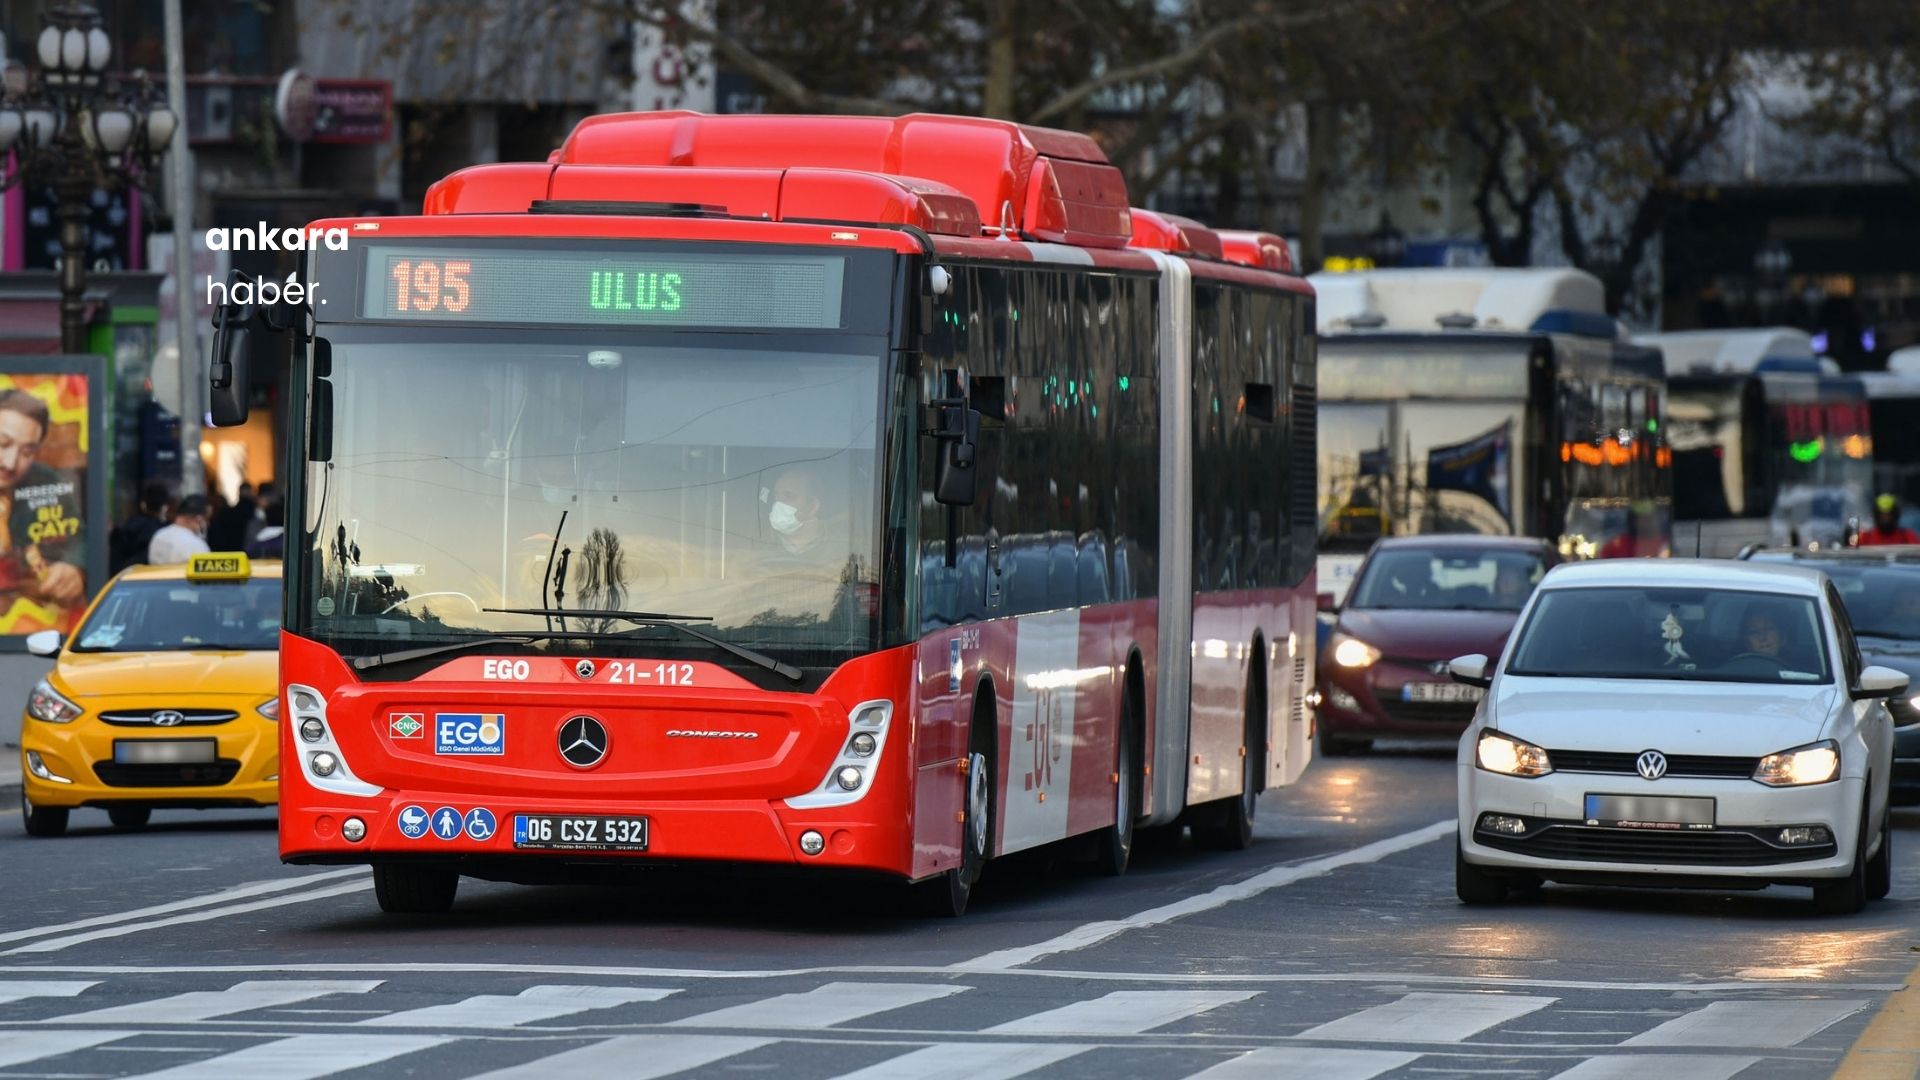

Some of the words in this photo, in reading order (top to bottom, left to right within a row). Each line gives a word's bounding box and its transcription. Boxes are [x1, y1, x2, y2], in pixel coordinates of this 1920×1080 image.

[393, 260, 472, 312] 195
[591, 272, 682, 311] ULUS
[37, 505, 64, 522] BU
[28, 516, 80, 544] ÇAY?
[483, 659, 530, 681] EGO
[609, 661, 694, 686] 21-112
[396, 722, 417, 731] CNG
[440, 722, 501, 745] EGO
[666, 730, 759, 739] CONECTO
[528, 819, 552, 841] 06
[561, 819, 598, 842] CSZ
[605, 820, 642, 843] 532
